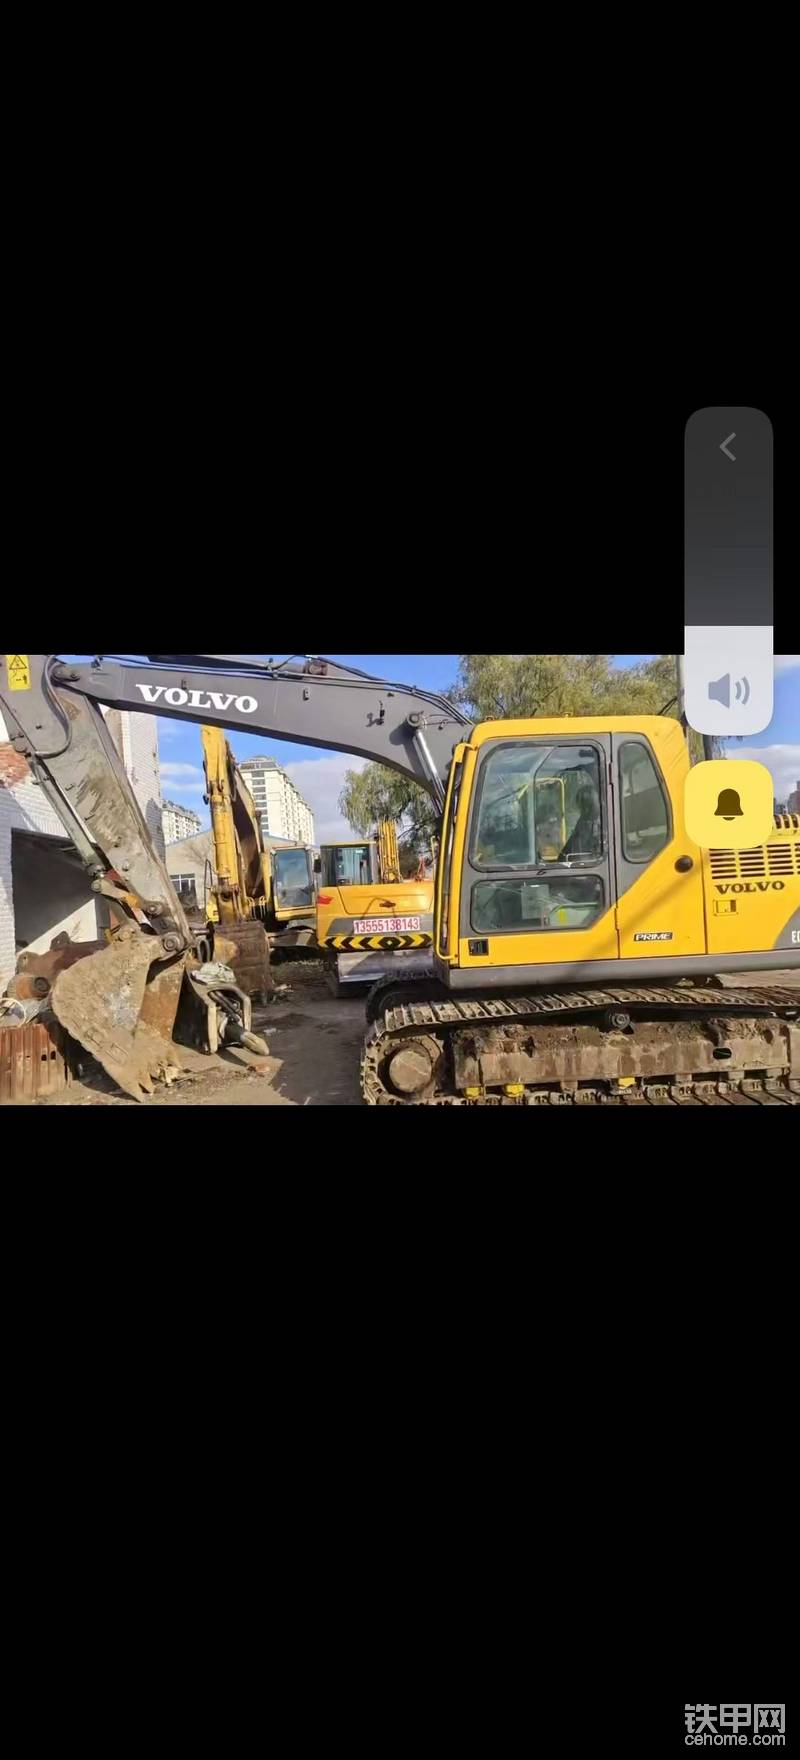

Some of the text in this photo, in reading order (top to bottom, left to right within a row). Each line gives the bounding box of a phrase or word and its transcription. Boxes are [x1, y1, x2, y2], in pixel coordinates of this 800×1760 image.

[136, 684, 258, 713] VOLVO
[715, 881, 785, 895] VOLVO
[635, 932, 671, 941] PRIME
